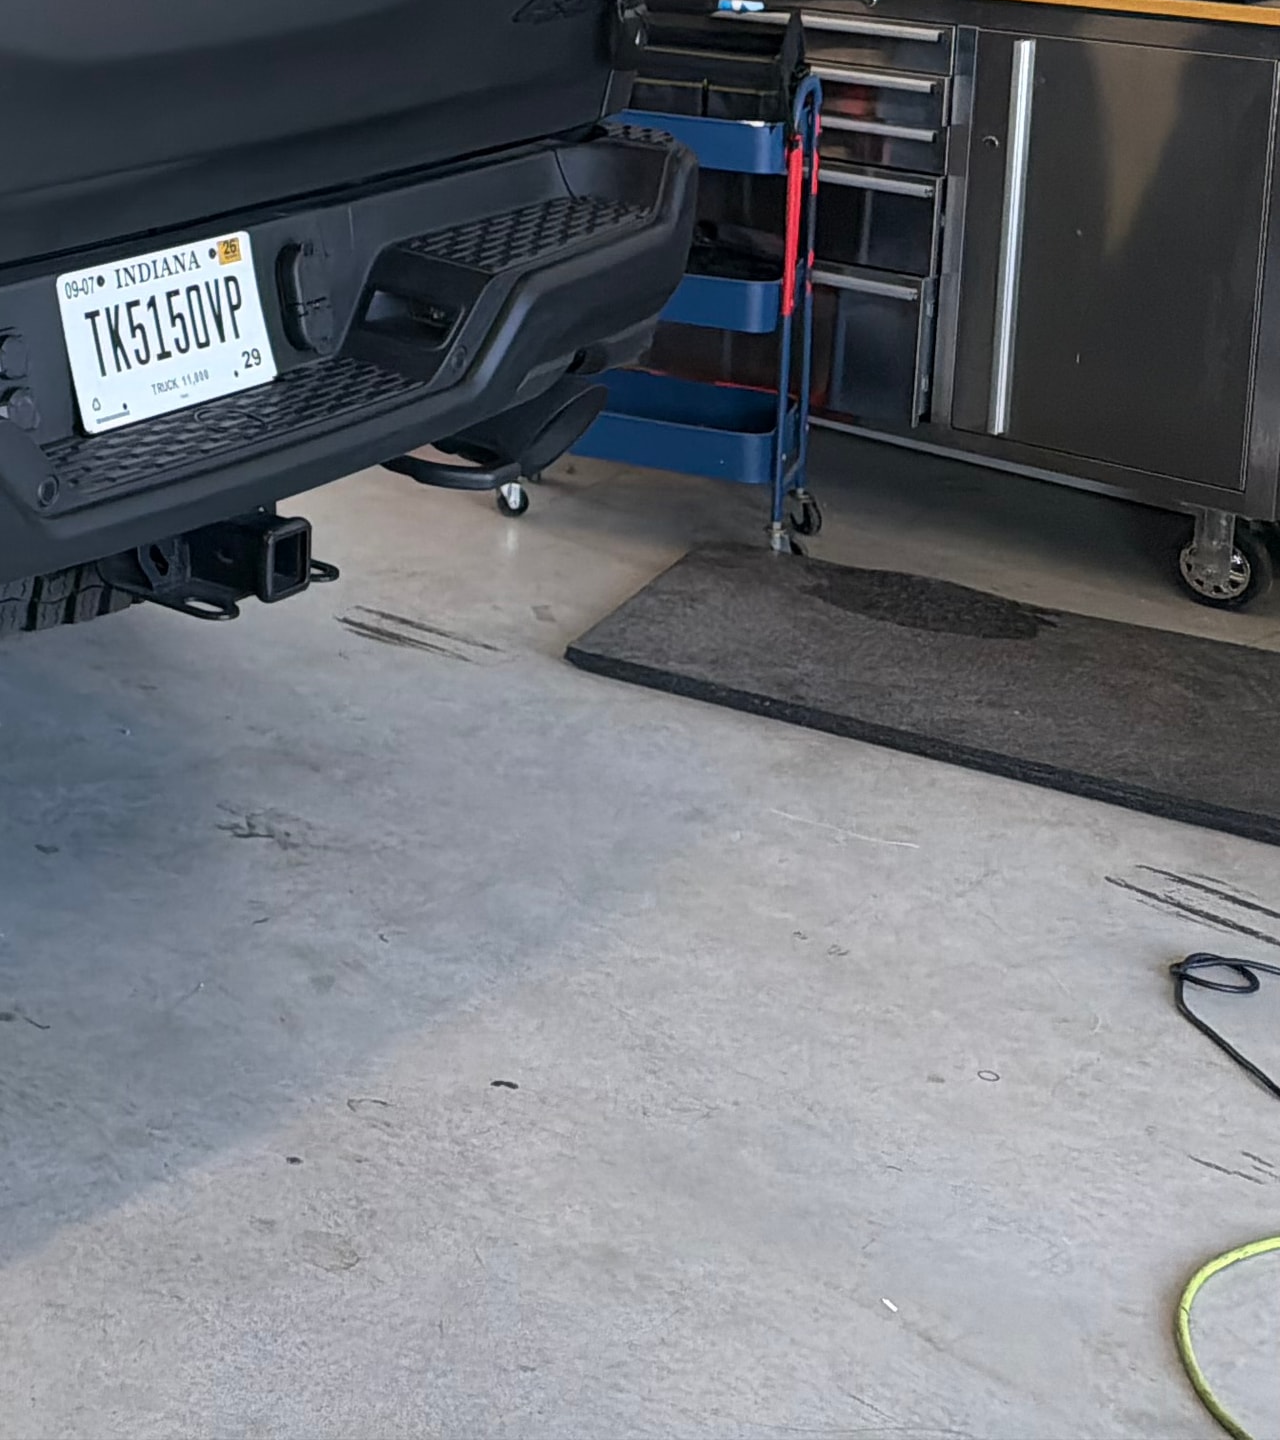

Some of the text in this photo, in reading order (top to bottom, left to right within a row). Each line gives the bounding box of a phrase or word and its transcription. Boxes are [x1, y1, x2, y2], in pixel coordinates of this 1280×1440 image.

[223, 238, 238, 254] 26
[64, 250, 201, 300] 09-07 INDIANA
[241, 348, 262, 369] 29
[151, 377, 180, 396] TRUCK
